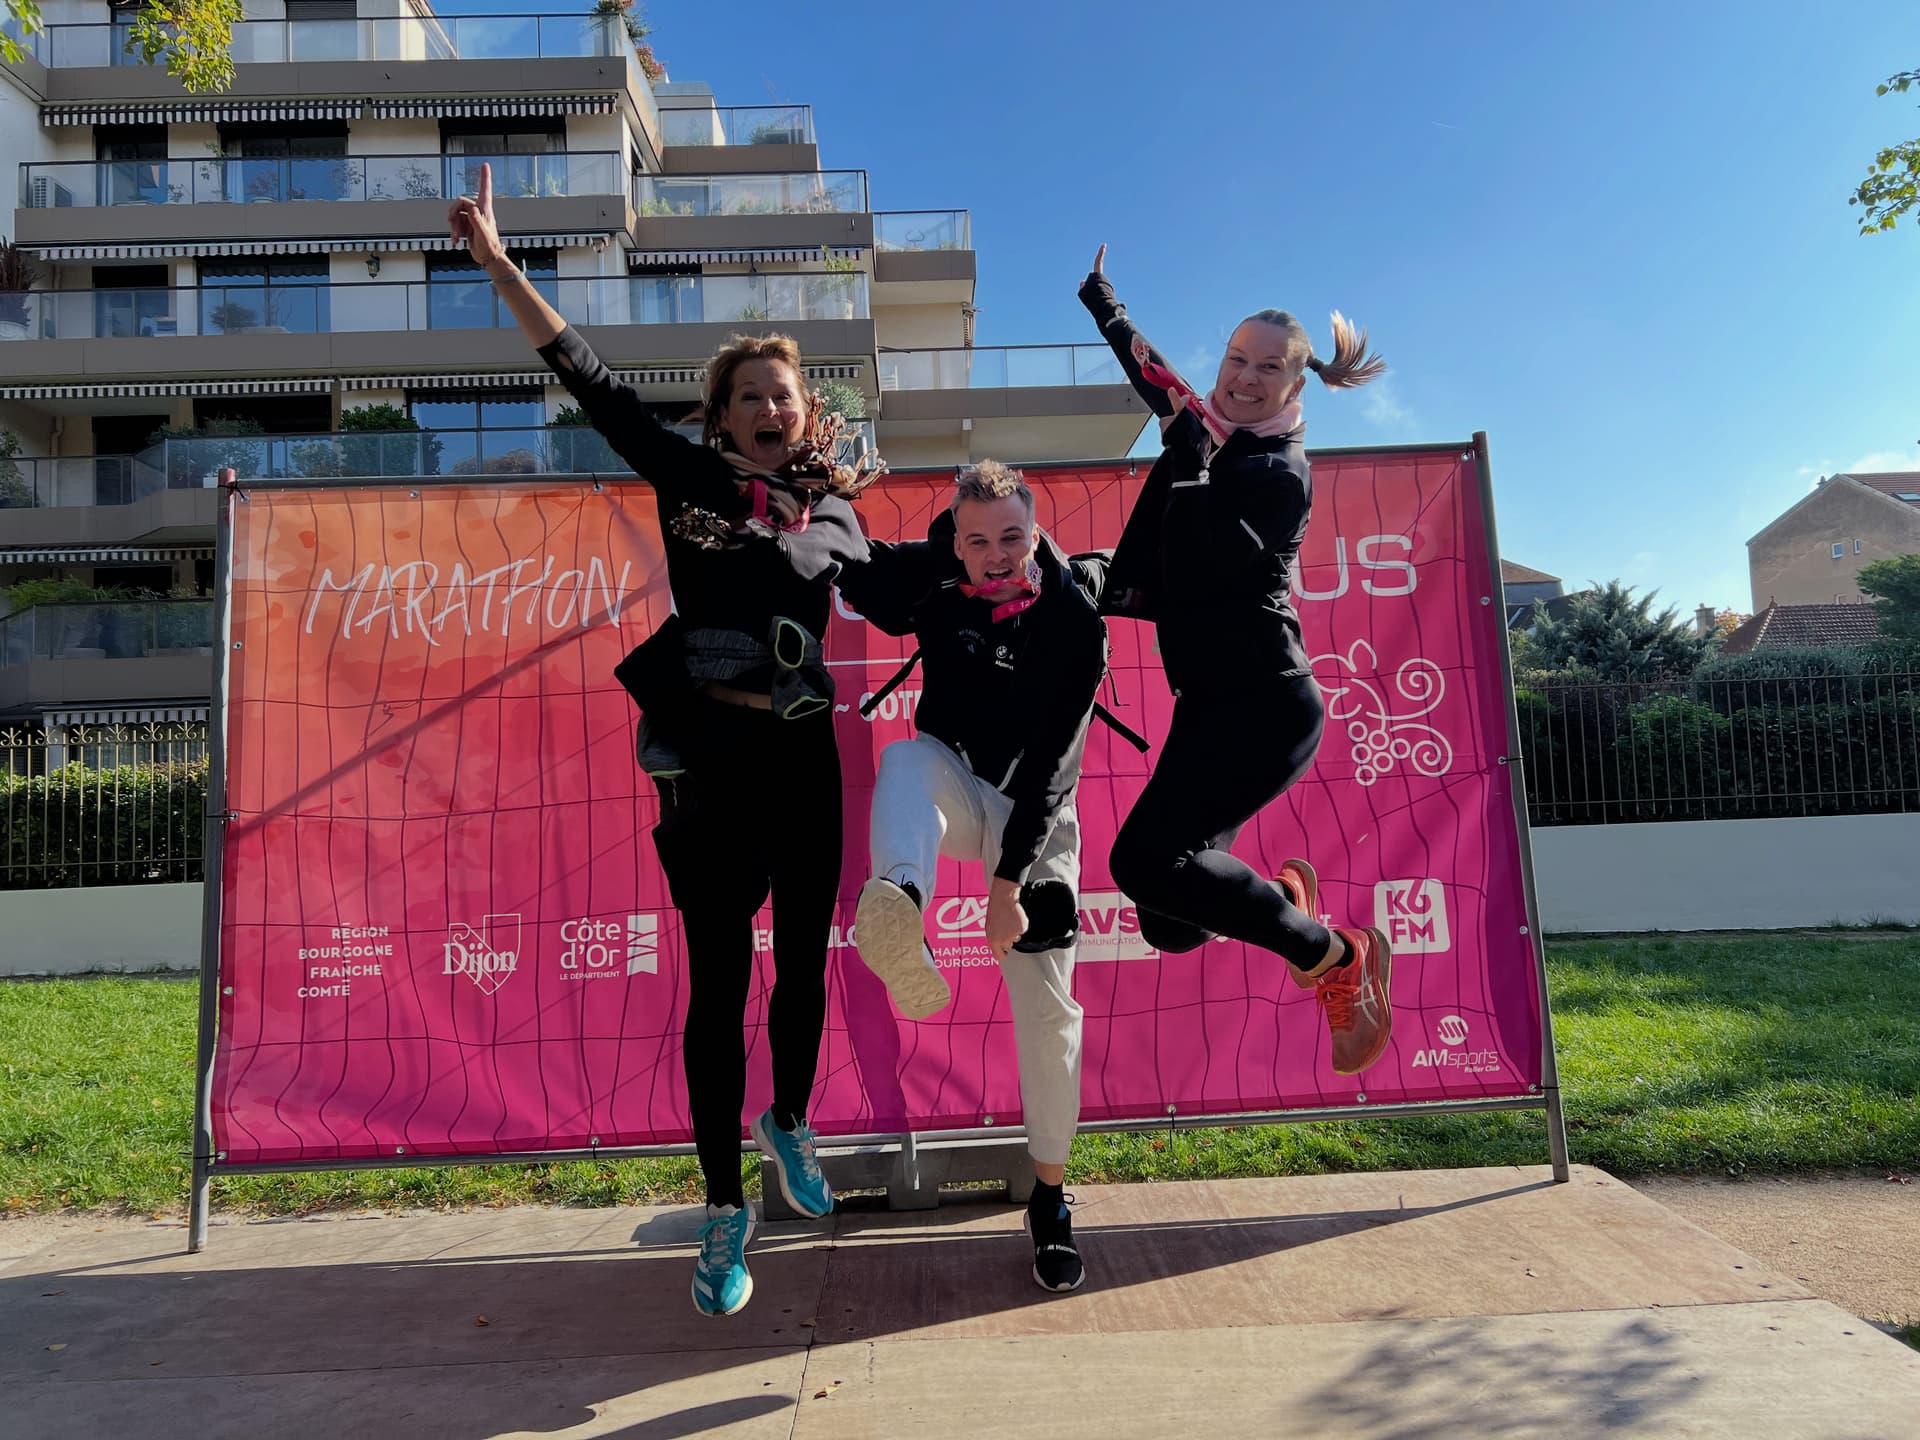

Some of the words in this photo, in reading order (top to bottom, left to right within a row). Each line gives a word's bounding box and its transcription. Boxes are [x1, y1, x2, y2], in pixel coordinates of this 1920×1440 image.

[306, 555, 632, 646] MARATHON
[560, 917, 621, 943] Côte
[1387, 916, 1436, 944] FM
[298, 944, 393, 960] BOURGOGNE
[933, 945, 993, 957] HAMPAG
[310, 965, 382, 979] FRANCHE
[442, 942, 517, 985] Dijon
[1412, 1048, 1499, 1069] AMsports
